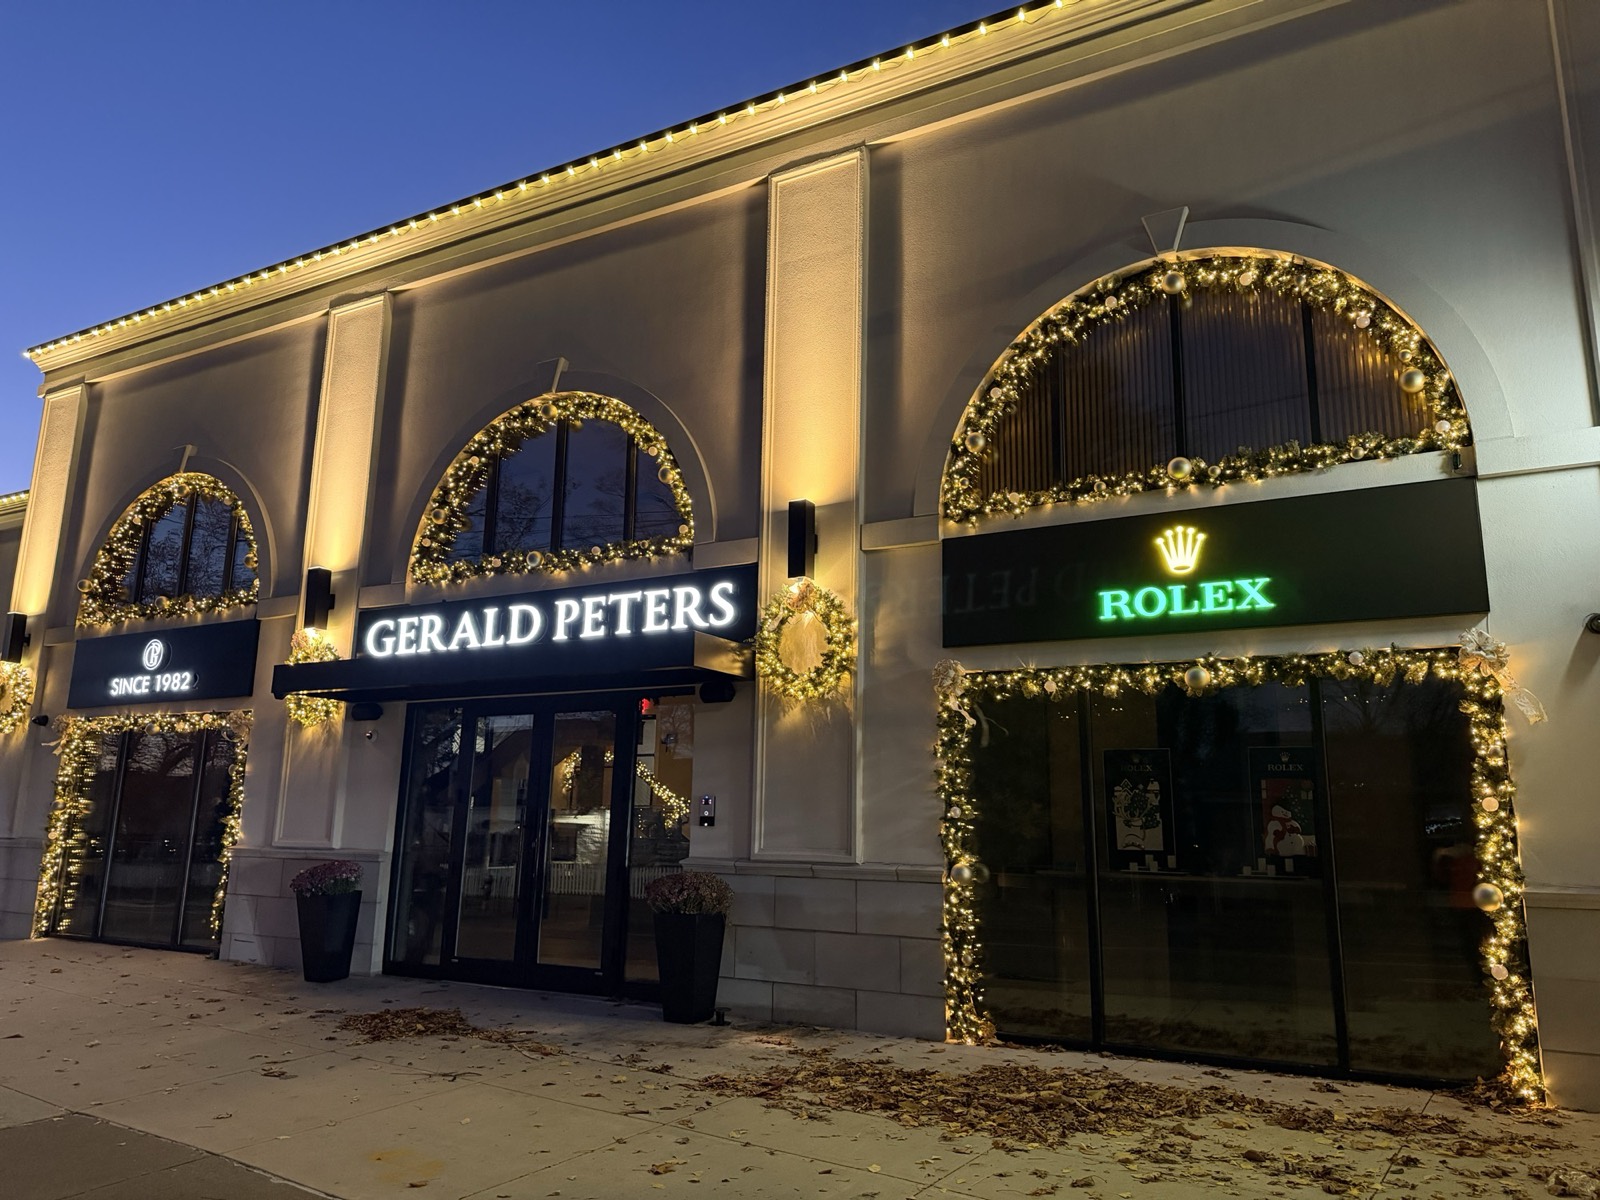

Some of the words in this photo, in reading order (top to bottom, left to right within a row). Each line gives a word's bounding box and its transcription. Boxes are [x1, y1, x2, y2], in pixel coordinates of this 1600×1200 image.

[1098, 577, 1276, 621] ROLEX
[366, 604, 542, 658] GERALD
[552, 582, 735, 641] PETERS
[110, 675, 150, 696] SINCE
[154, 671, 191, 692] 1982
[1267, 763, 1304, 772] ROLEX
